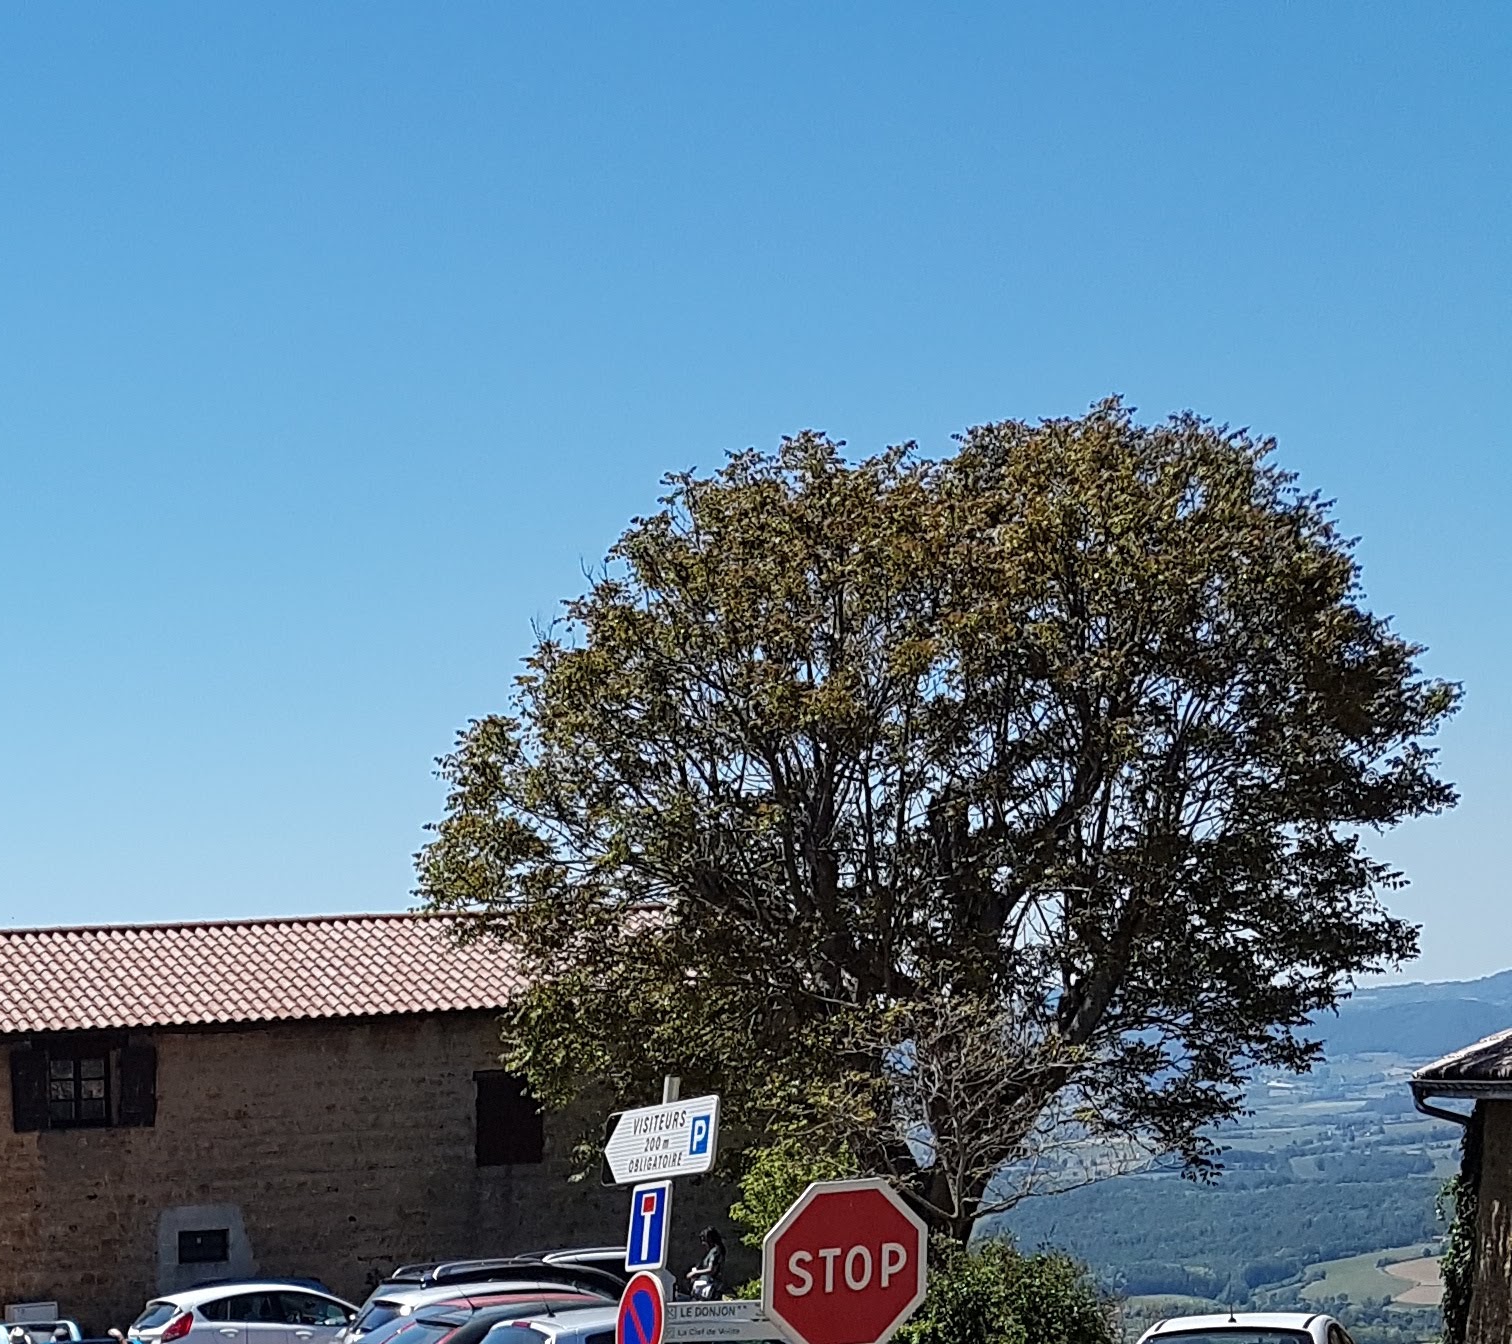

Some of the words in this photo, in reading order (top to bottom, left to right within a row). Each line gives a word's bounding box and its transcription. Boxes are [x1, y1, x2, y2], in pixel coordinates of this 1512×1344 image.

[633, 1110, 687, 1135] VISITEURS
[644, 1136, 661, 1152] 200
[692, 1119, 707, 1152] P
[628, 1152, 683, 1173] OBLIGATOIRE
[785, 1242, 907, 1297] STOP
[680, 1307, 693, 1318] LE
